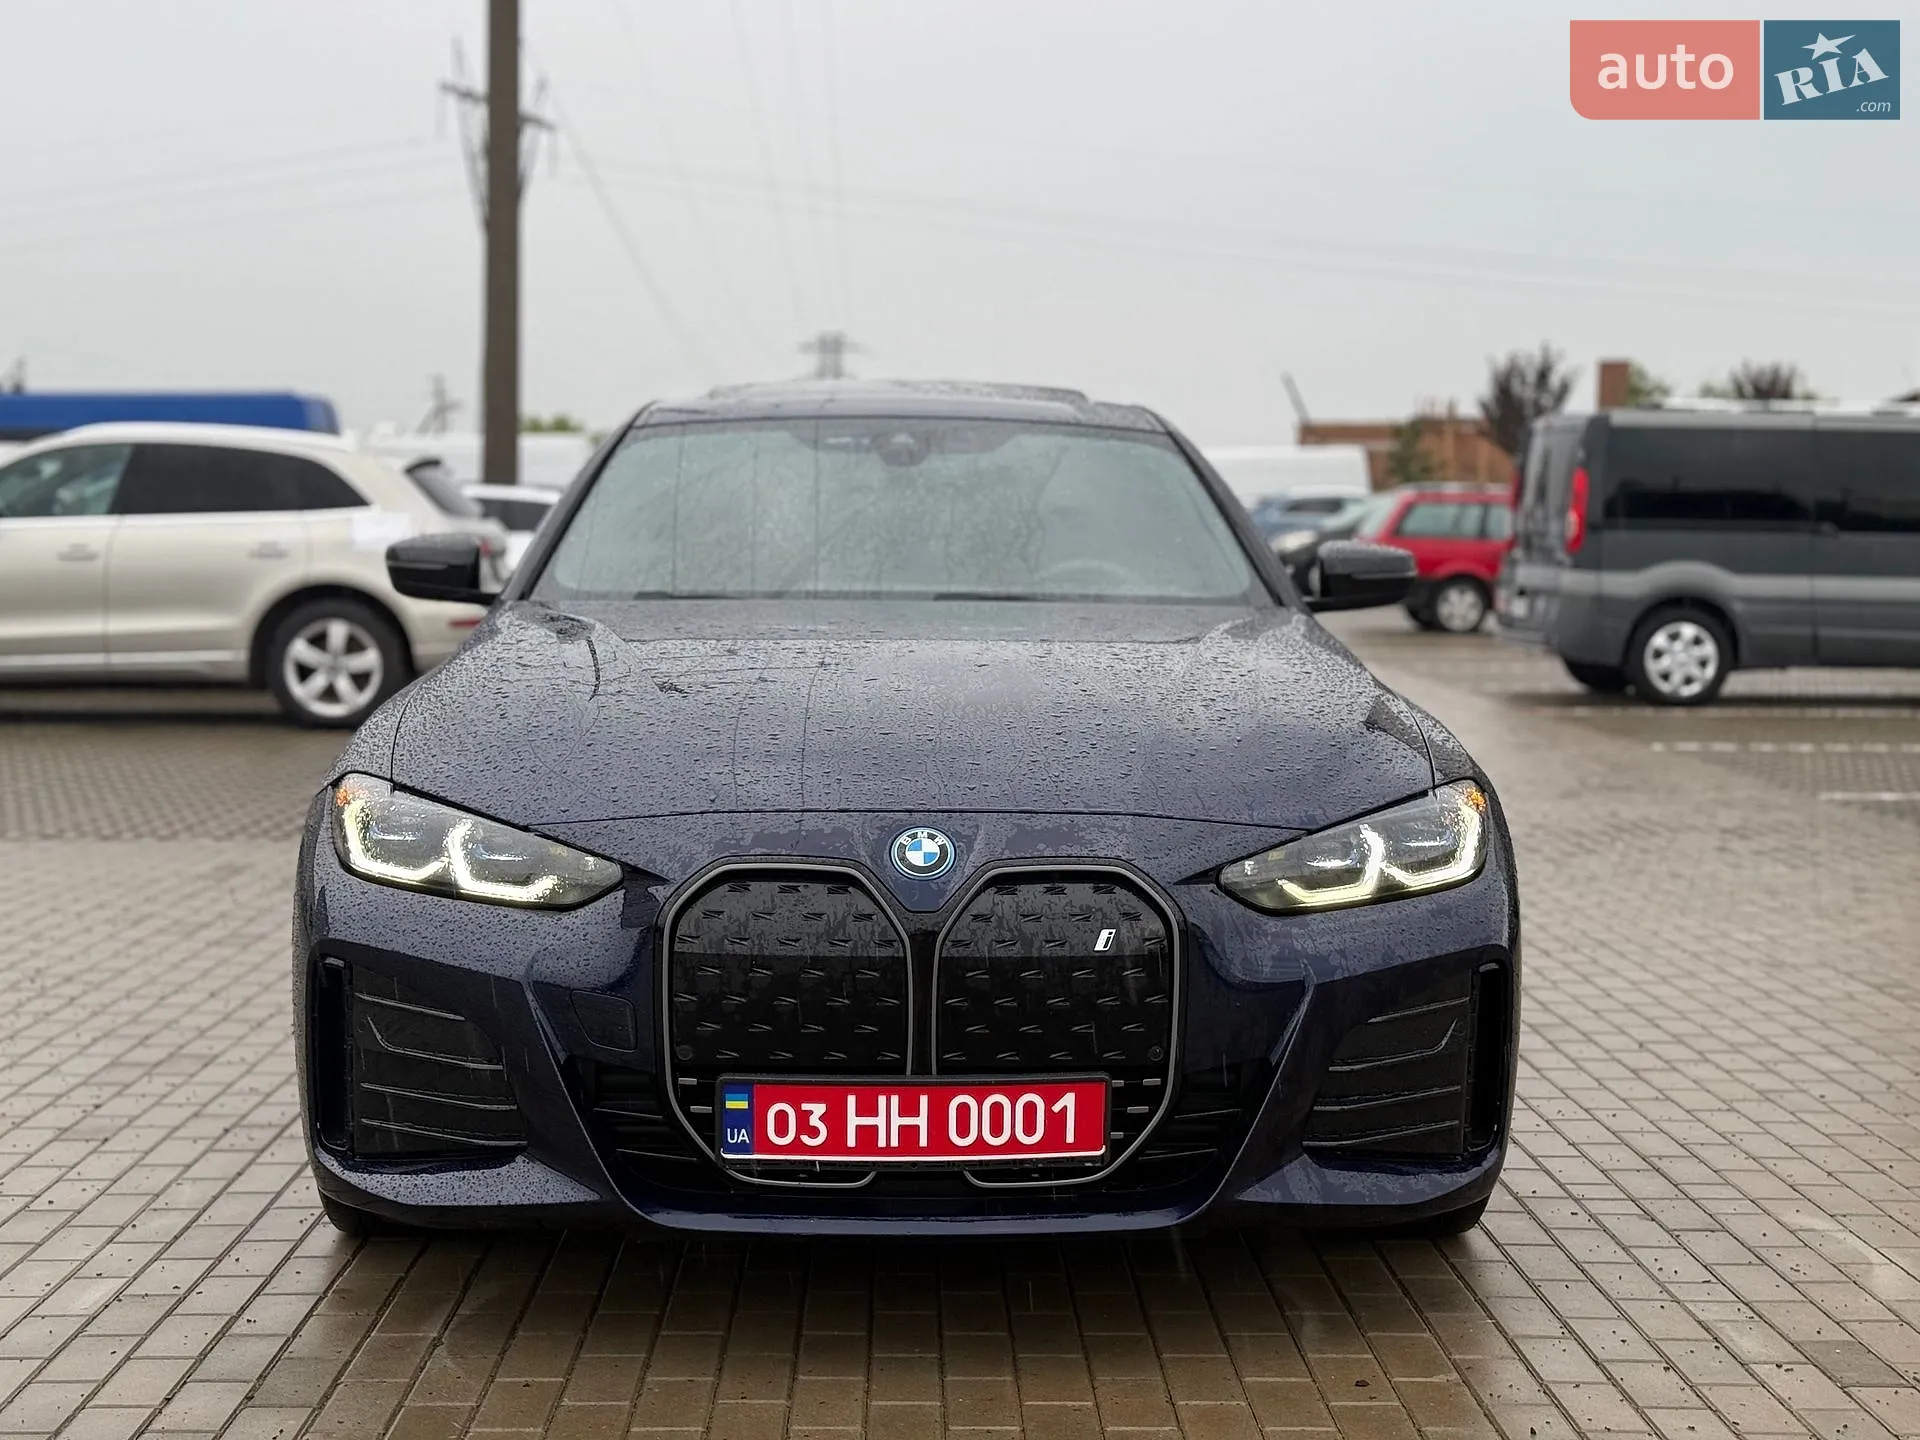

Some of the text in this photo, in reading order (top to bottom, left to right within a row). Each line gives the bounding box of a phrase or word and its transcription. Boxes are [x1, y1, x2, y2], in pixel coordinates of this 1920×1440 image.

[899, 831, 947, 846] BMW
[765, 1092, 1076, 1148] 03 HH 0001
[726, 1127, 750, 1145] UA
